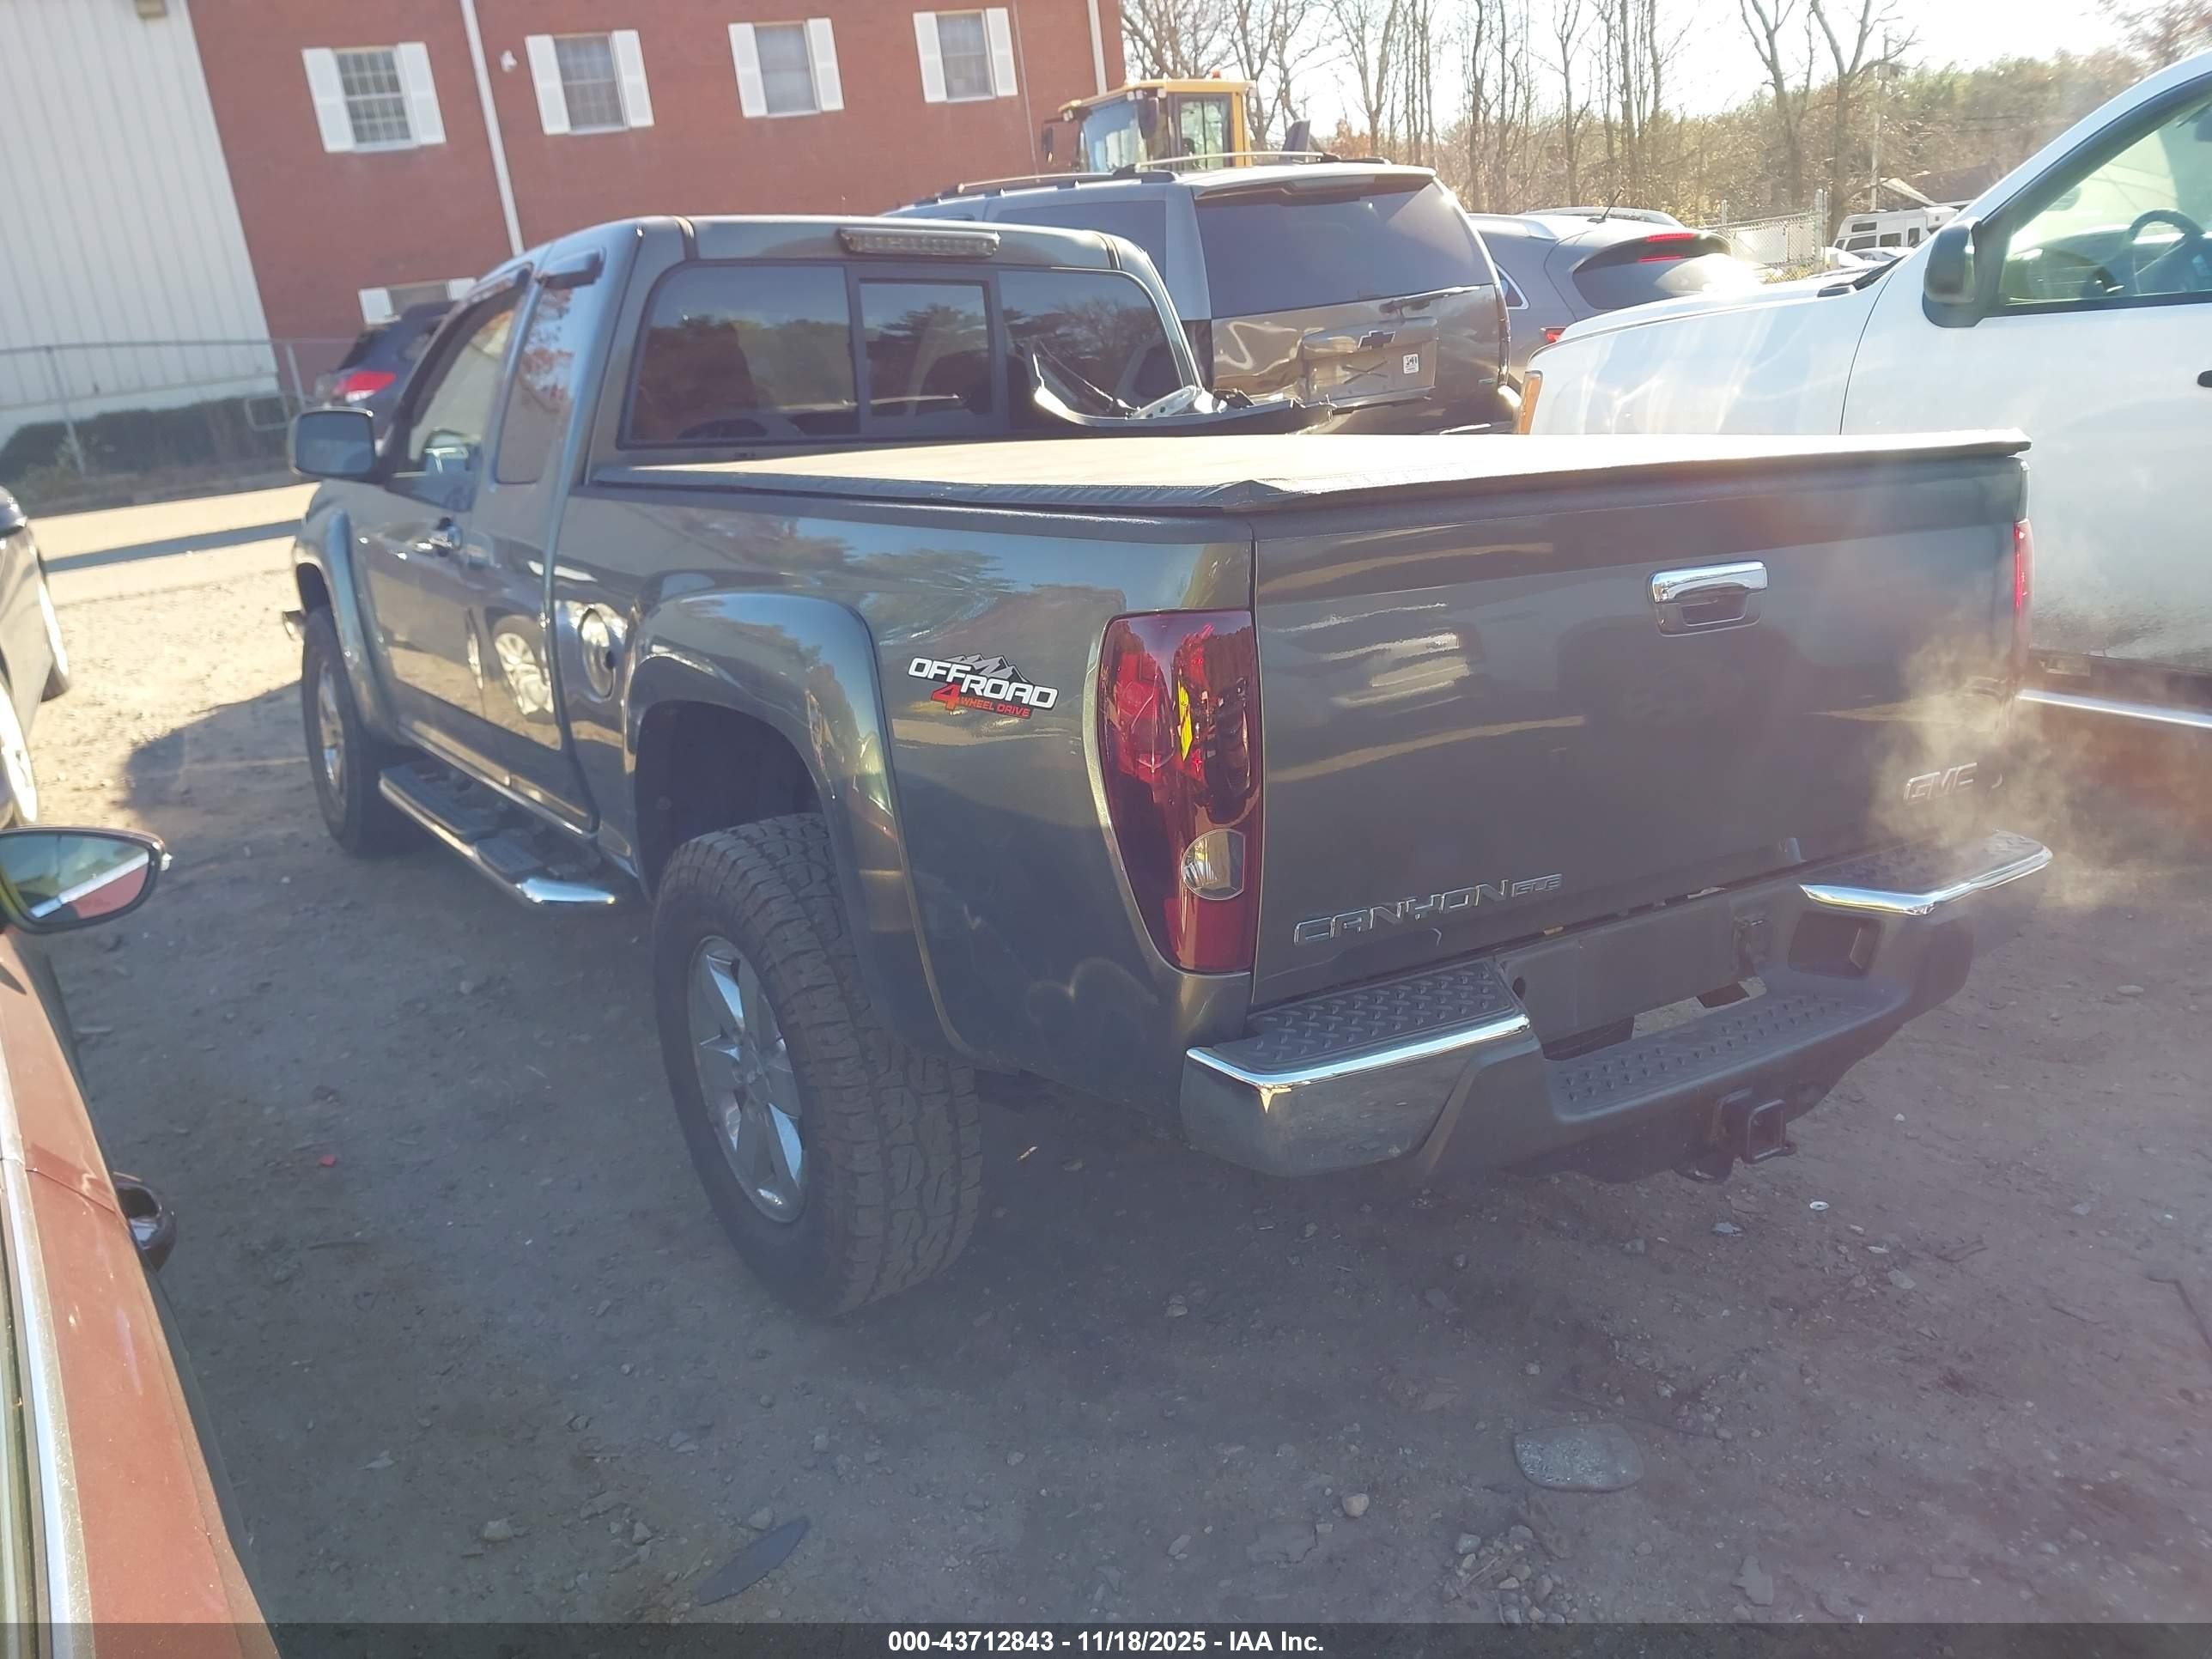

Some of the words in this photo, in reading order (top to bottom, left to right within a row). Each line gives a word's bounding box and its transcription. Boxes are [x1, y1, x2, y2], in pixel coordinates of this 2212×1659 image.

[932, 684, 961, 710] 4
[961, 696, 994, 710] WHEEL
[997, 704, 1030, 717] DRIVE
[1293, 879, 1509, 945] CANYON
